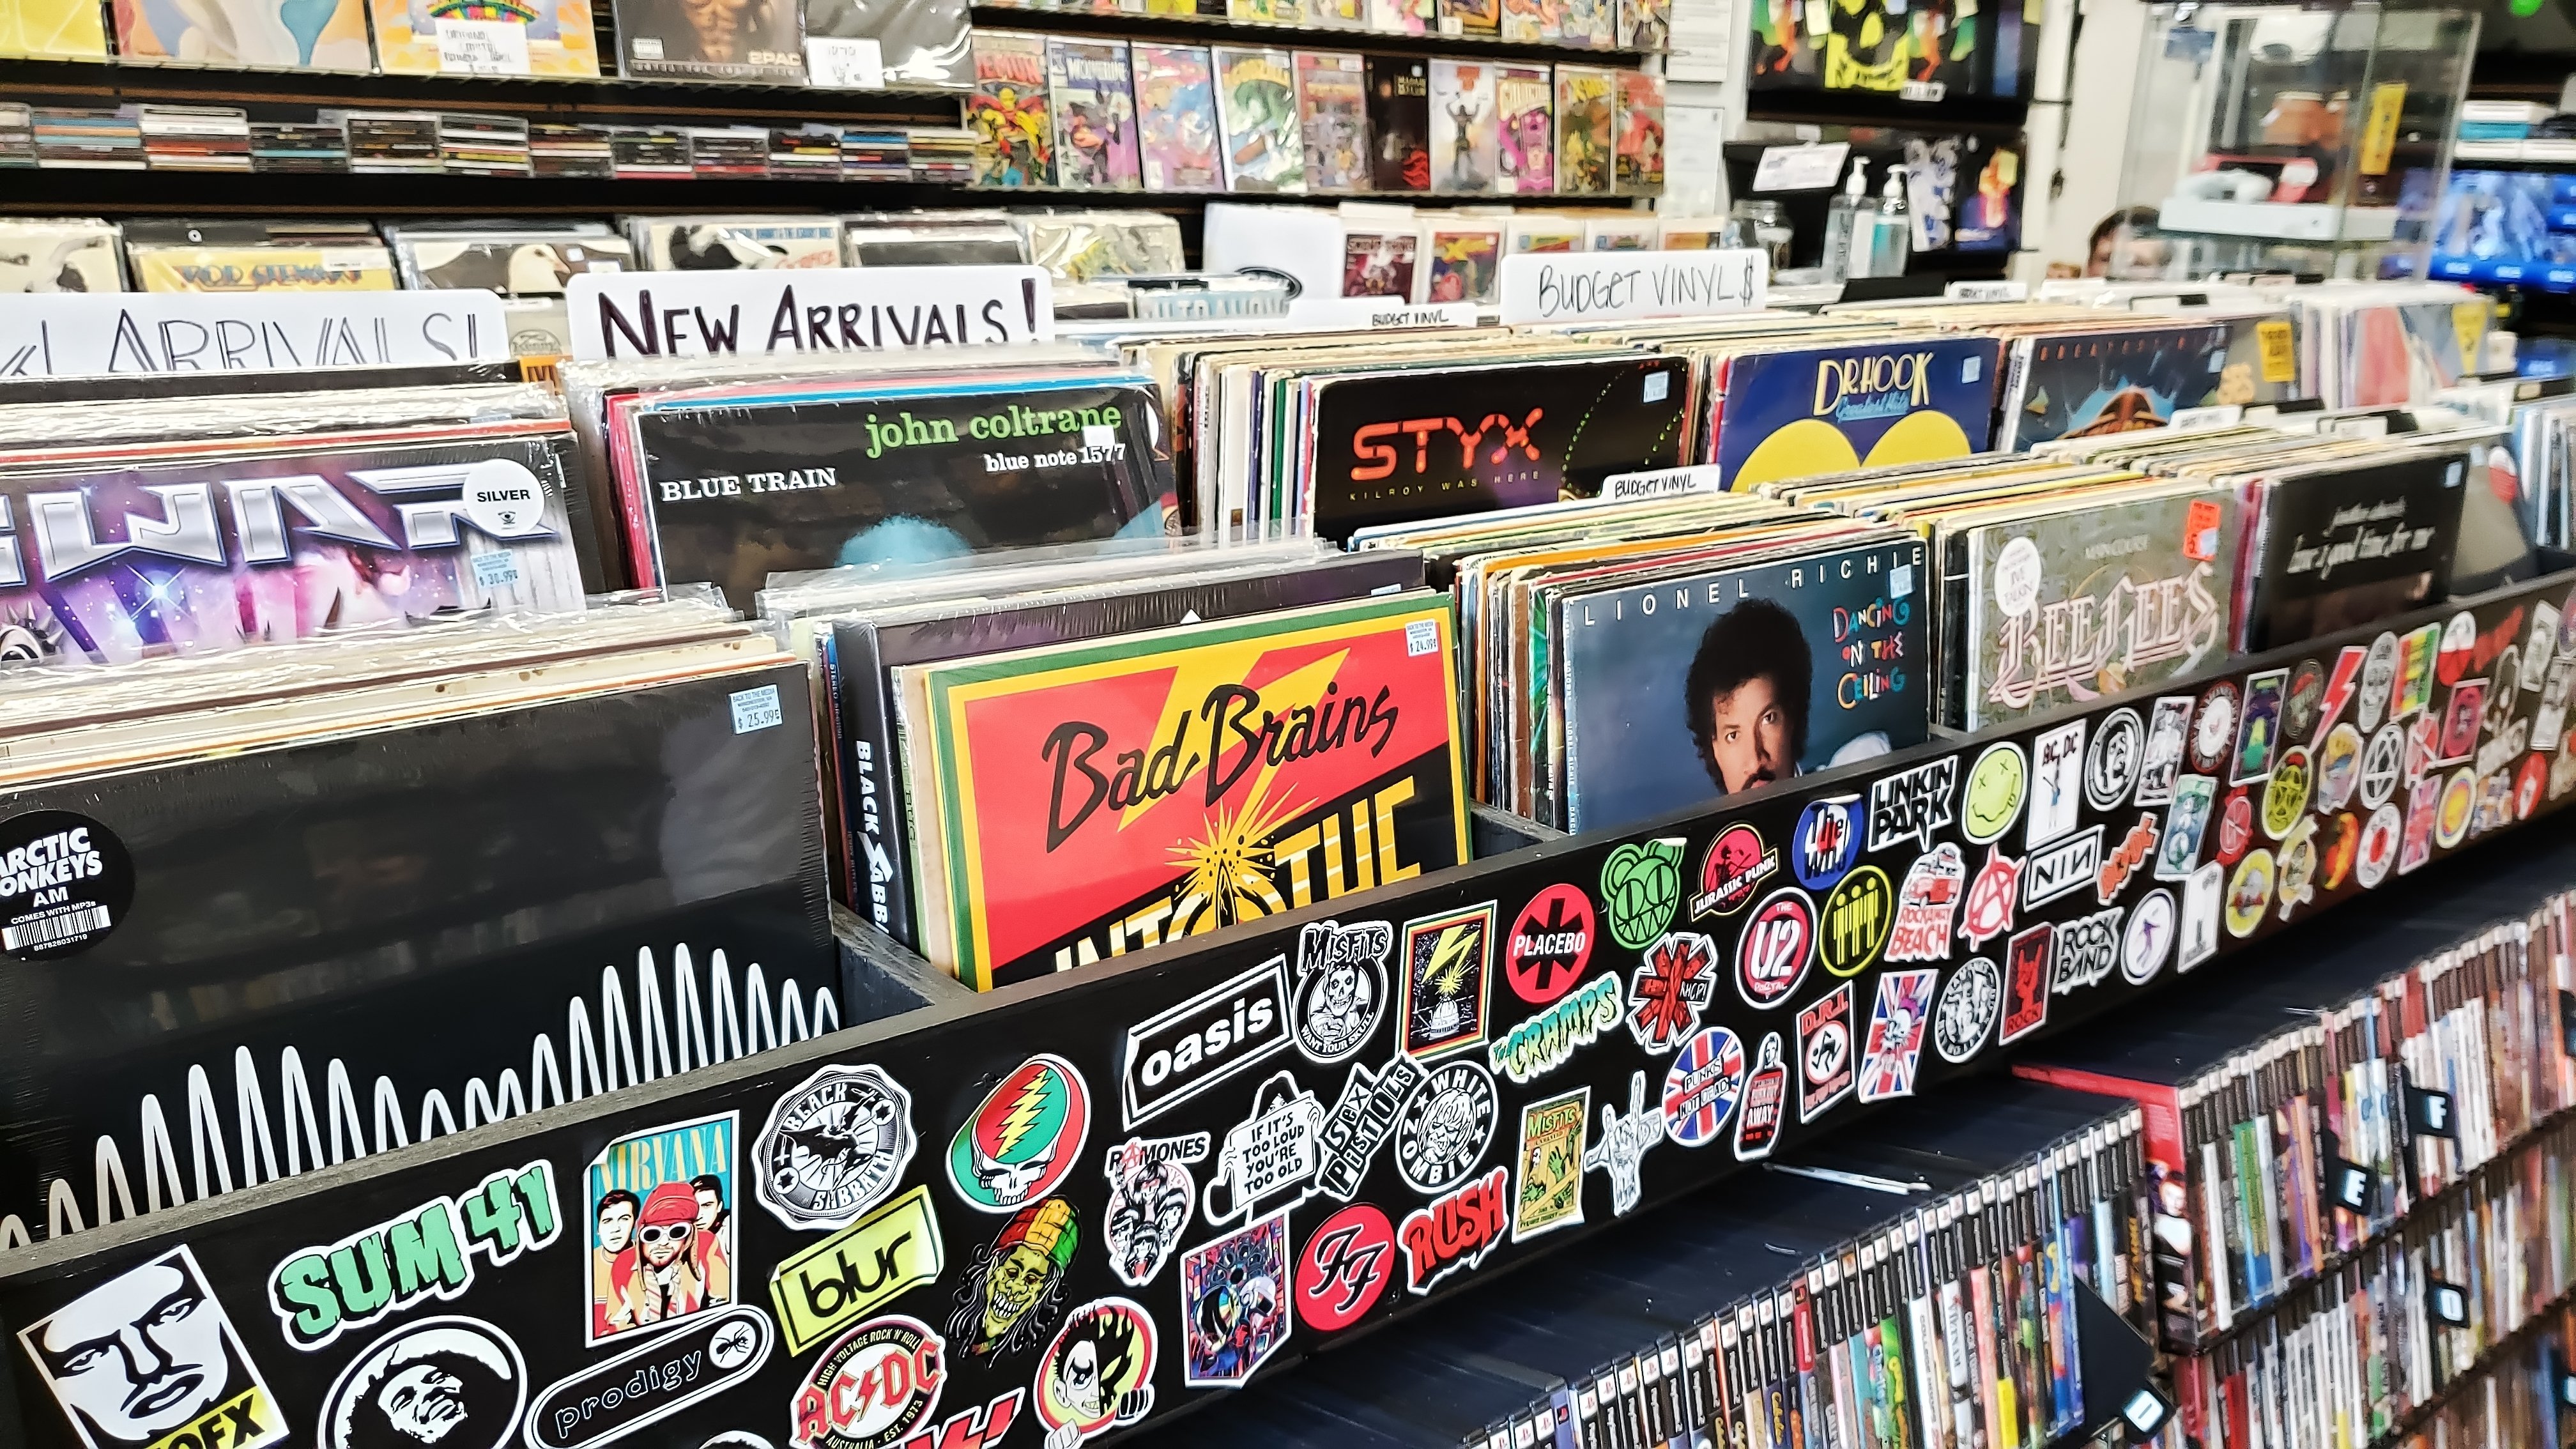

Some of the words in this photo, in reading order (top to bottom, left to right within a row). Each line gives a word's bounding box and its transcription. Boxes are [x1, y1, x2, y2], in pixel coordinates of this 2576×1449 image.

[1538, 265, 1642, 318] BUDGET
[1651, 265, 1736, 303] VINYL
[1738, 256, 1755, 307] $
[598, 289, 741, 359] NEW
[767, 278, 1038, 353] ARRIVALS!
[864, 411, 959, 459] john
[969, 404, 1123, 441] coltrane
[1351, 406, 1544, 481] STYX
[984, 450, 1029, 473] blue
[1033, 448, 1077, 468] note
[1080, 443, 1127, 466] 1577
[477, 489, 531, 503] SILVER
[660, 477, 741, 503] BLUE
[747, 466, 837, 494] TRAIN
[1350, 483, 1425, 502] KILROY
[1441, 479, 1478, 491] WAS
[1494, 470, 1541, 484] HERE
[1614, 479, 1659, 499] BUDGET
[1662, 472, 1697, 492] VINYL
[1583, 578, 1750, 626] LIONEL
[1790, 546, 1924, 589] RICHIE
[1832, 597, 1910, 643] DANCING
[1841, 640, 1864, 668] ON
[1870, 631, 1905, 661] THE
[1837, 666, 1906, 710] CEILING
[856, 740, 880, 835] BLACK
[1041, 710, 1201, 854] Bad
[1200, 681, 1399, 808] Brains
[1875, 763, 1952, 810] LINKIN
[1872, 788, 1949, 845] PARK
[0, 850, 103, 897] ONKEYS
[1694, 877, 1744, 914] JURASSIC
[1744, 854, 1776, 884] PUNK
[2034, 846, 2092, 891] NIN
[11, 910, 46, 924] COMES
[46, 906, 71, 917] WITH
[71, 901, 96, 911] MP3s
[33, 886, 69, 907] AM
[1300, 925, 1389, 972] MISFITS
[1512, 931, 1587, 958] PLACEBO
[1750, 919, 1800, 979] U2
[1889, 924, 1948, 956] BEACH
[1141, 995, 1274, 1087] oasis
[1300, 1023, 1322, 1052] WANT
[1322, 1039, 1349, 1054] YOUR
[1347, 1011, 1374, 1045] SKULL
[1506, 977, 1618, 1076] CRAMPS
[786, 1082, 848, 1131] BLACK
[1430, 1068, 1491, 1116] WHITE
[2427, 1096, 2447, 1130] F
[1251, 1124, 1264, 1144] IF
[1268, 1111, 1294, 1135] IT'S
[1527, 1108, 1576, 1140] MISFITS
[1746, 1104, 1774, 1128] AWAY
[595, 1124, 727, 1201] NIRVANA
[1243, 1142, 1271, 1163] TOO
[1273, 1124, 1305, 1148] LOUD
[1246, 1142, 1297, 1178] YOU'RE
[1404, 1117, 1475, 1186] ZOMBIE
[1245, 1171, 1275, 1195] TOO
[1278, 1157, 1303, 1179] OLD
[2345, 1171, 2366, 1207] E
[1406, 1169, 1506, 1278] RUSH
[279, 1204, 468, 1337] SUM
[464, 1165, 556, 1251] 41
[799, 1230, 913, 1319] blur
[817, 1362, 838, 1386] HIGH
[833, 1333, 869, 1363] VOLTAGE
[870, 1328, 892, 1343] ROCK
[901, 1331, 921, 1350] ROLL
[553, 1349, 703, 1440] prodigy
[901, 1399, 924, 1424] 1973
[150, 1393, 268, 1449] OFX
